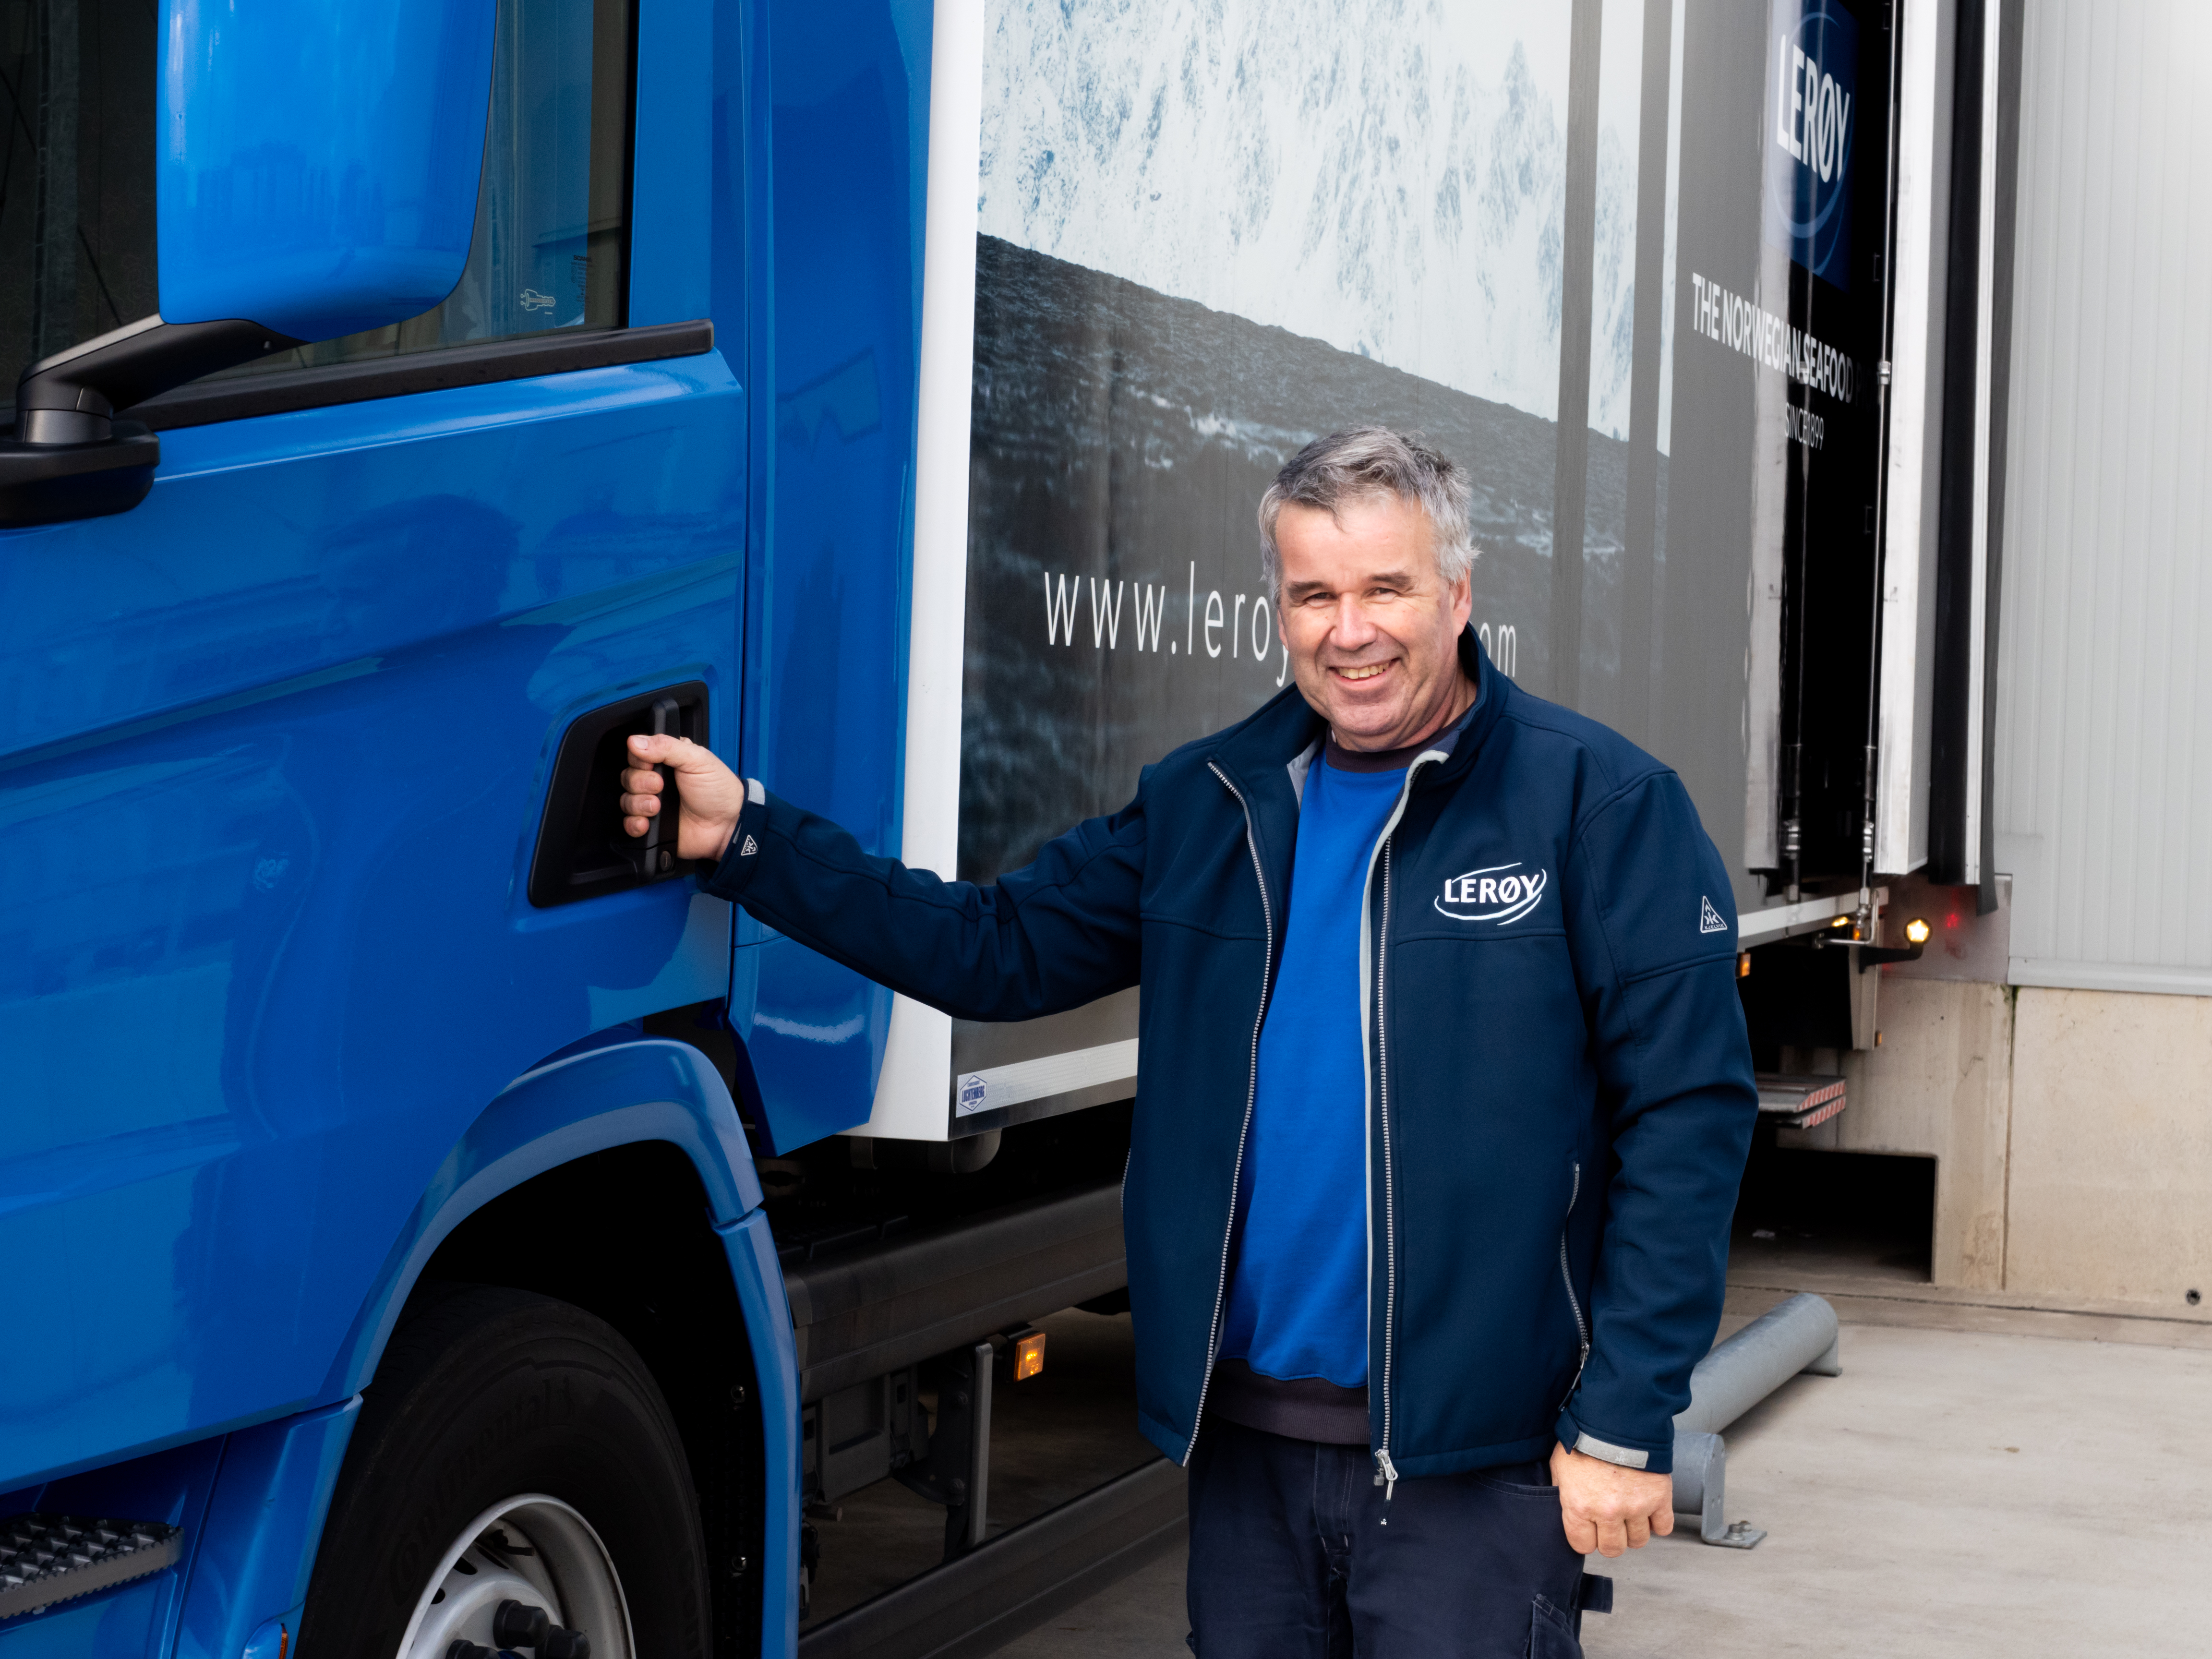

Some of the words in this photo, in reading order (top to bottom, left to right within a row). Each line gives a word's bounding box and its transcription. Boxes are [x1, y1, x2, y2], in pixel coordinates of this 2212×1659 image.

[1777, 34, 1850, 183] LERØY
[1693, 272, 1720, 341] THE
[1722, 289, 1801, 380] NORWEGIAN
[1802, 333, 1854, 404] SEAFOOD
[1785, 402, 1808, 445] SINCE
[1807, 412, 1824, 450] 1899
[1444, 875, 1540, 903] LERØY
